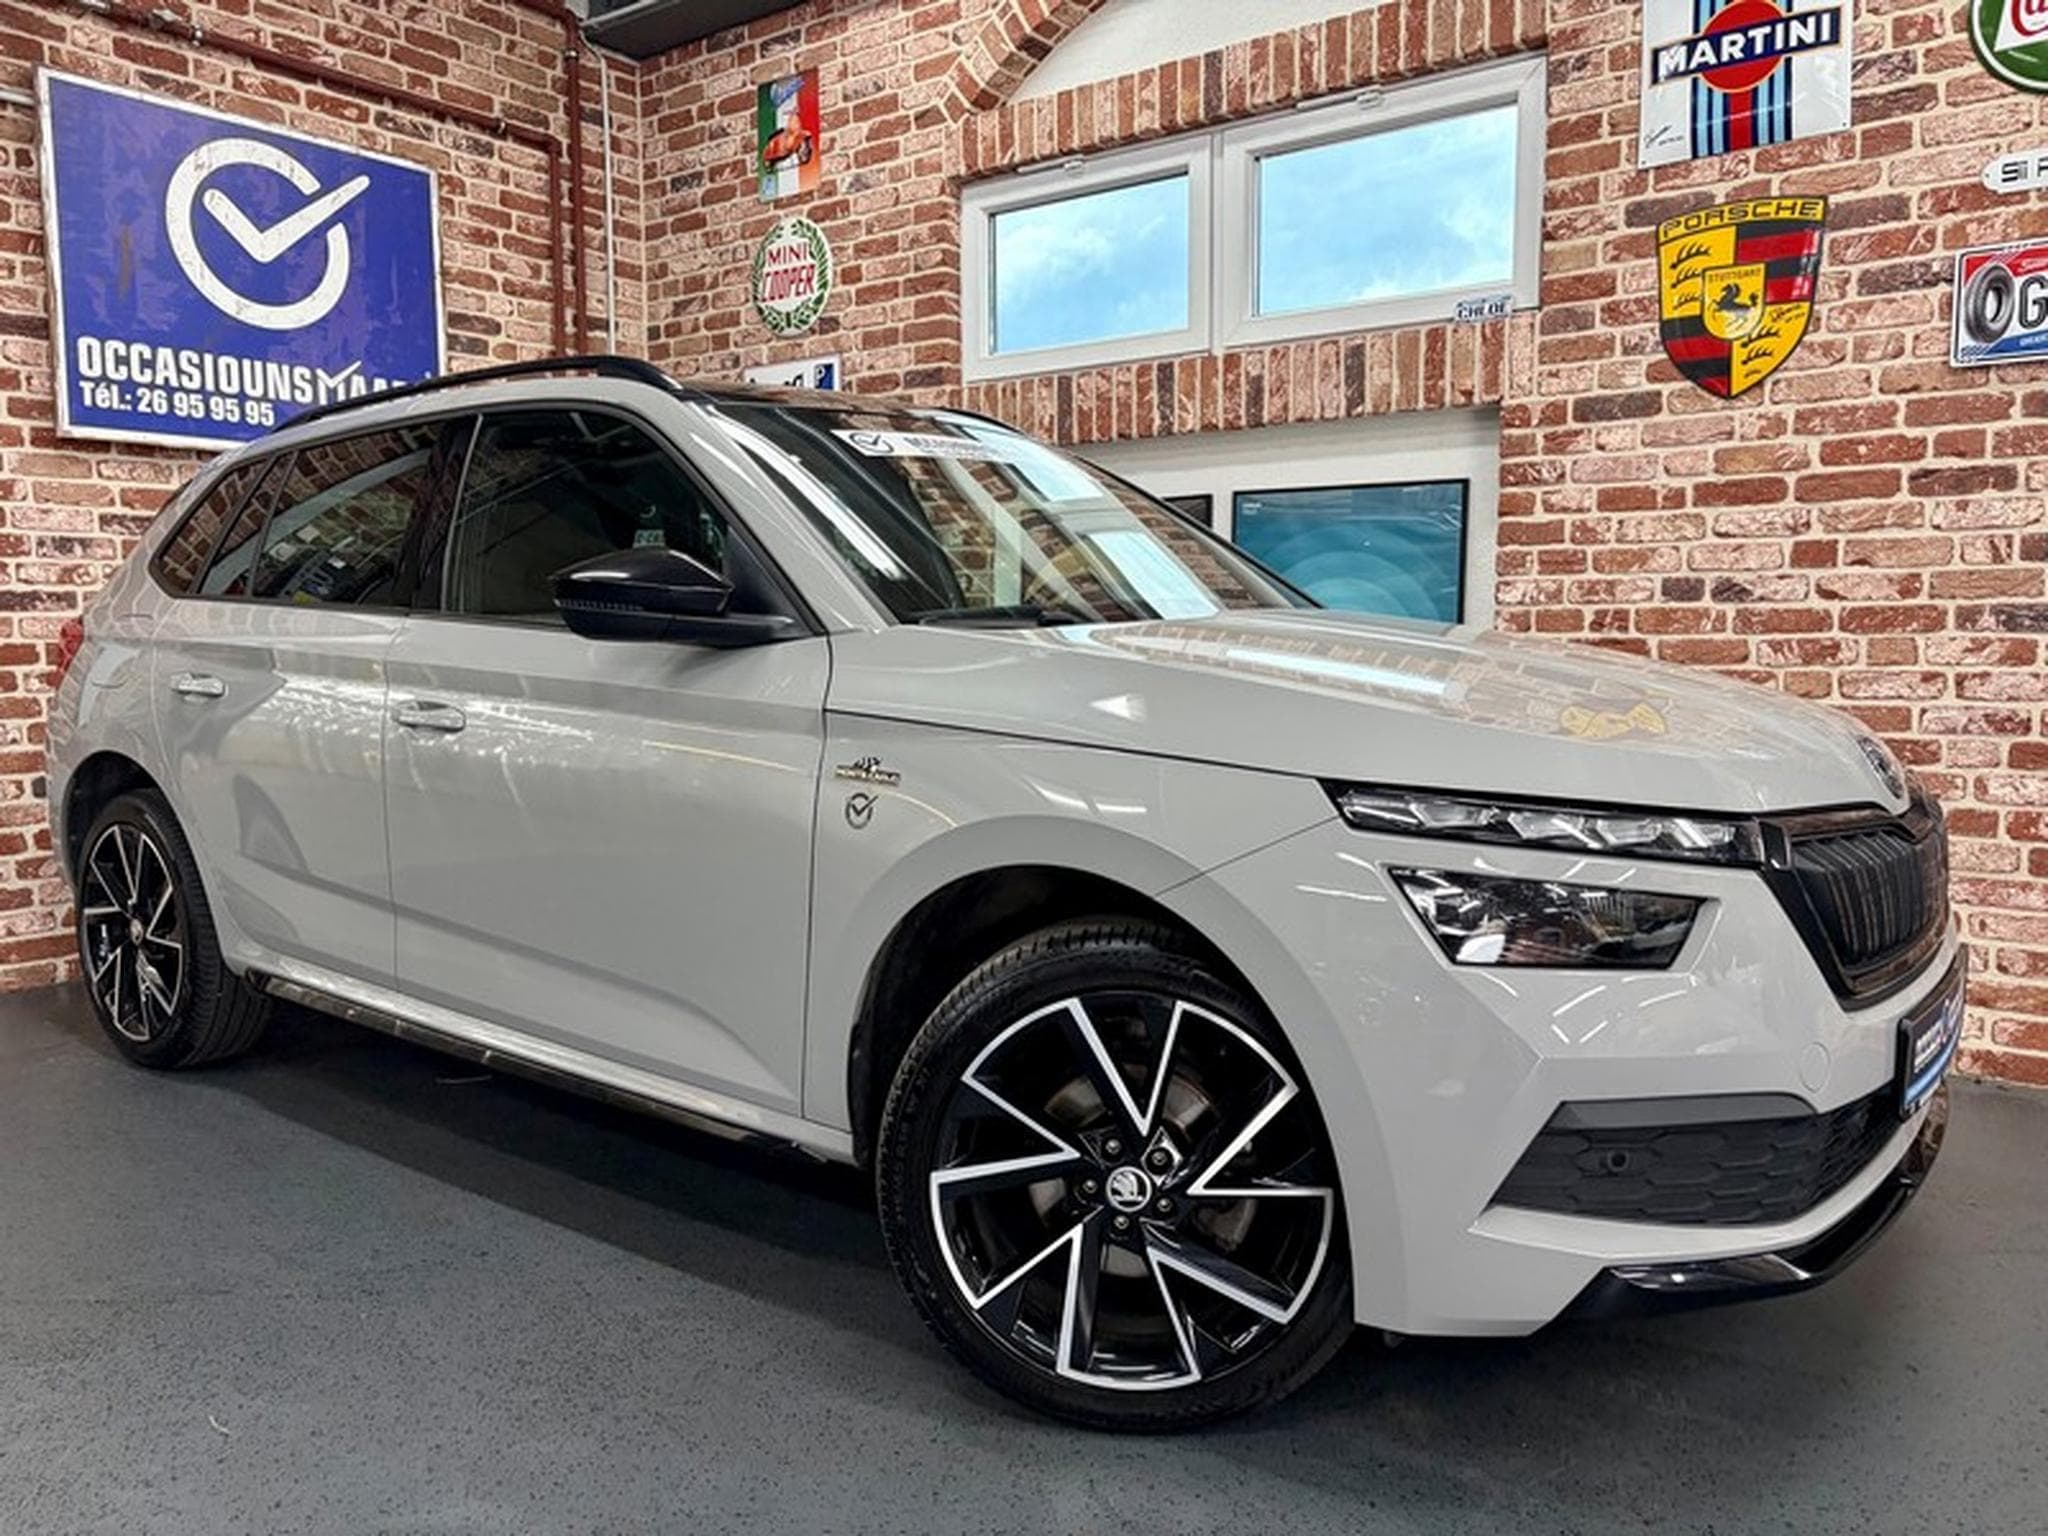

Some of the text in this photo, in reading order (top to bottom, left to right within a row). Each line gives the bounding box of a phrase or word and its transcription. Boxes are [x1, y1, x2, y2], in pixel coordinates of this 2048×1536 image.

[1658, 13, 1832, 79] MARTINI
[1663, 201, 1820, 238] PORSCHE
[767, 241, 808, 267] MINI
[762, 264, 816, 303] COOPER
[79, 381, 276, 427] Tél.: 26 95 95 95
